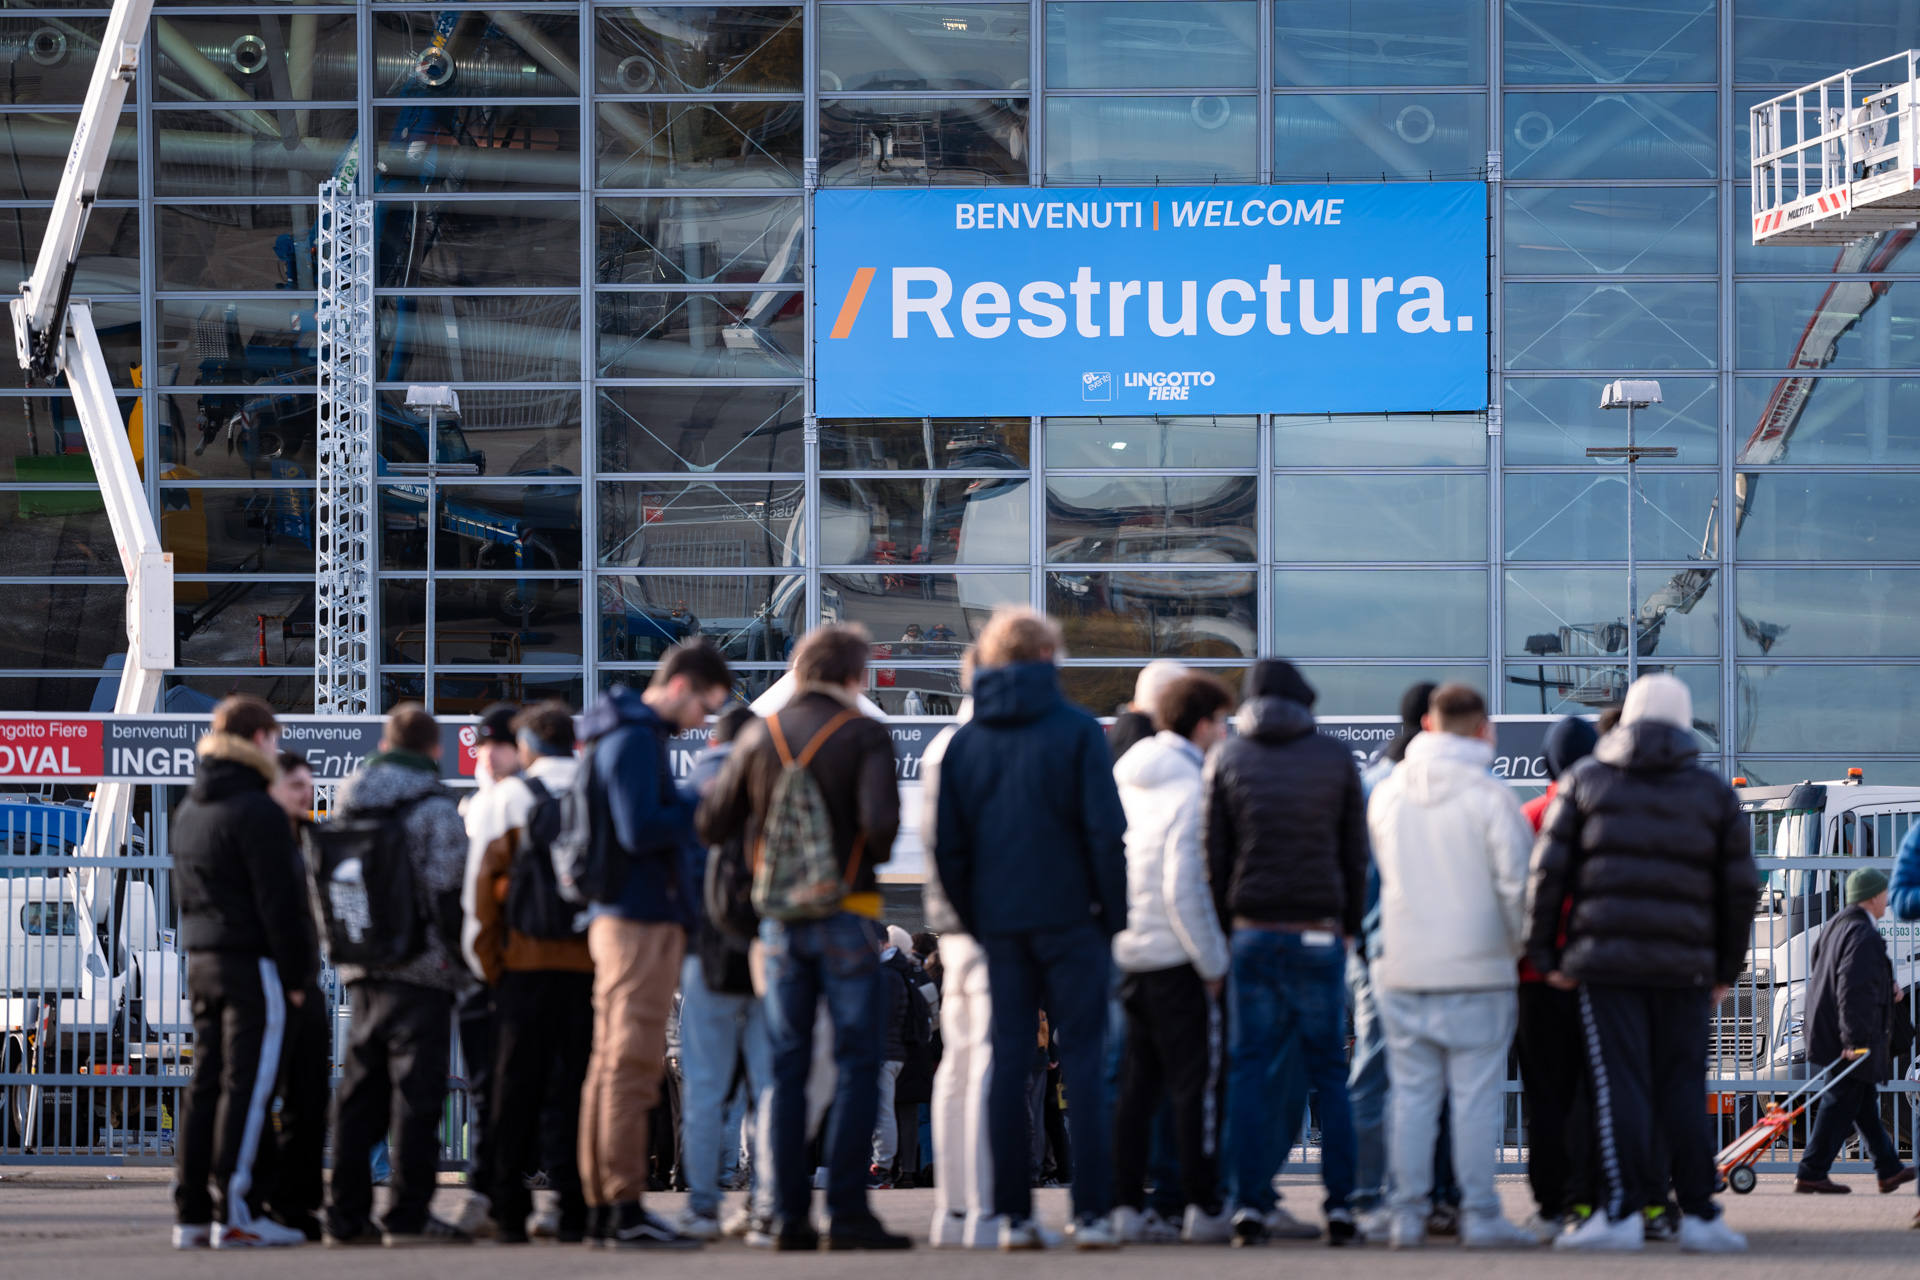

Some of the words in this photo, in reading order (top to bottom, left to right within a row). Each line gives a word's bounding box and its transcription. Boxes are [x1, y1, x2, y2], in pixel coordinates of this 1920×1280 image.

[956, 202, 1142, 229] BENVENUTI
[1171, 198, 1344, 227] WELCOME
[1787, 204, 1815, 221] MULTITEL
[1124, 371, 1216, 387] LINGOTTO
[1148, 386, 1190, 401] FIERE
[50, 722, 88, 738] Fiere
[113, 723, 187, 739] benvenuti
[281, 725, 362, 740] bienvenue
[0, 745, 81, 774] OVAL
